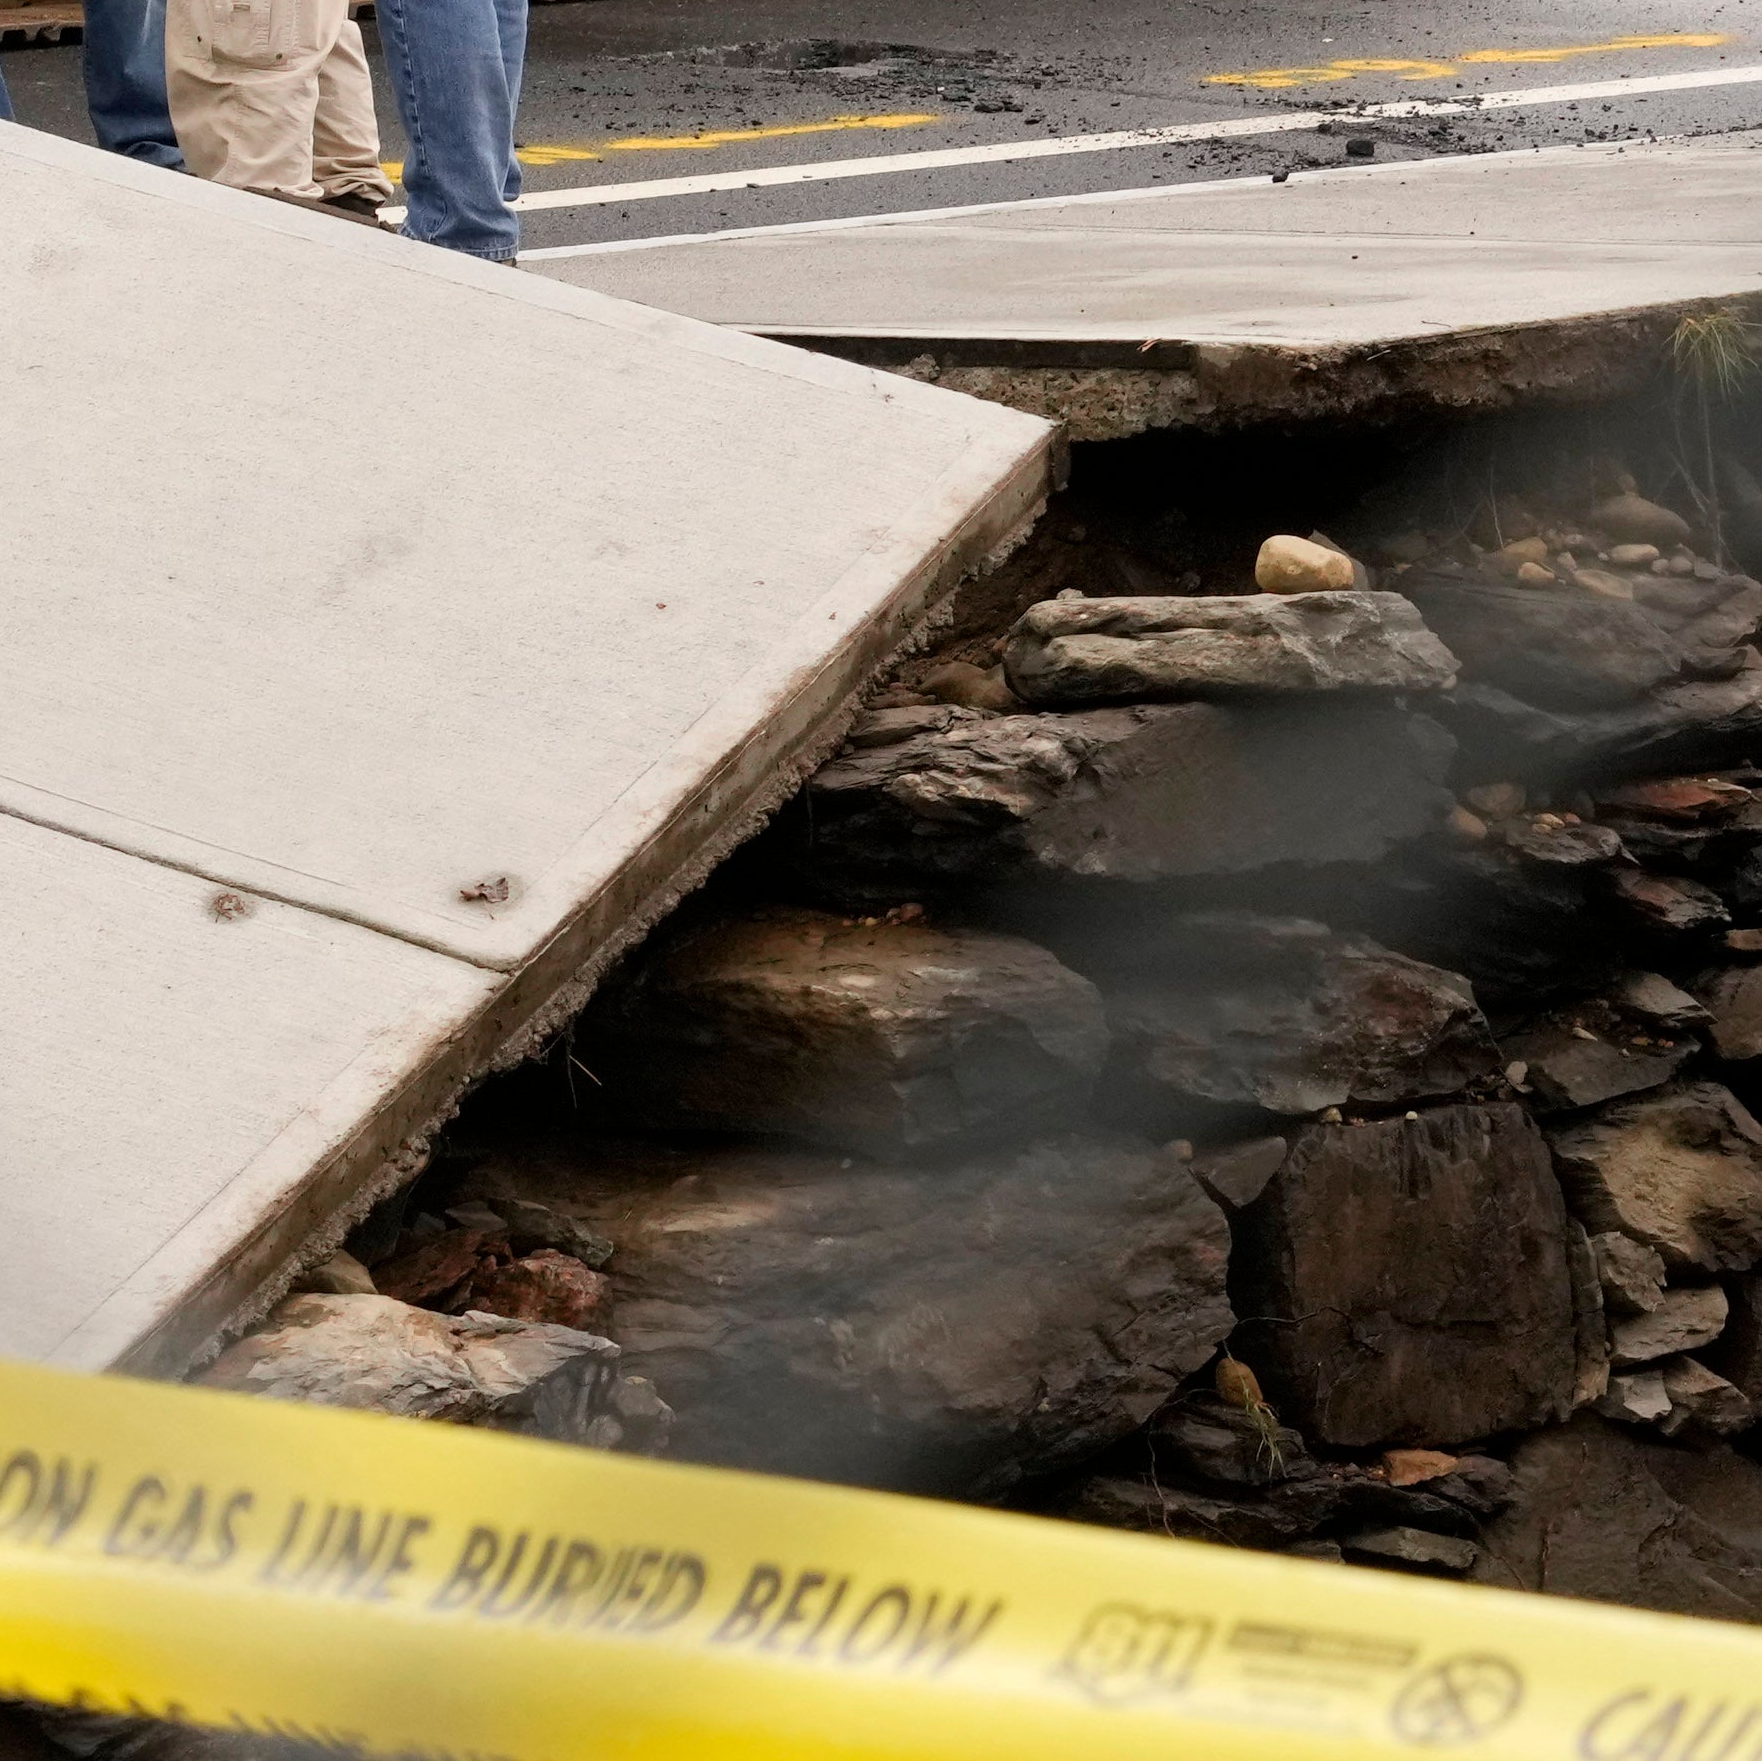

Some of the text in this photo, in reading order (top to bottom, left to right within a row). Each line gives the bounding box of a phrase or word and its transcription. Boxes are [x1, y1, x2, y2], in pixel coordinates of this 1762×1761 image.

[101, 1476, 257, 1569] GAS
[260, 1498, 432, 1605] LINE
[427, 1524, 707, 1636] BURIED
[719, 1562, 1004, 1679] BELOW
